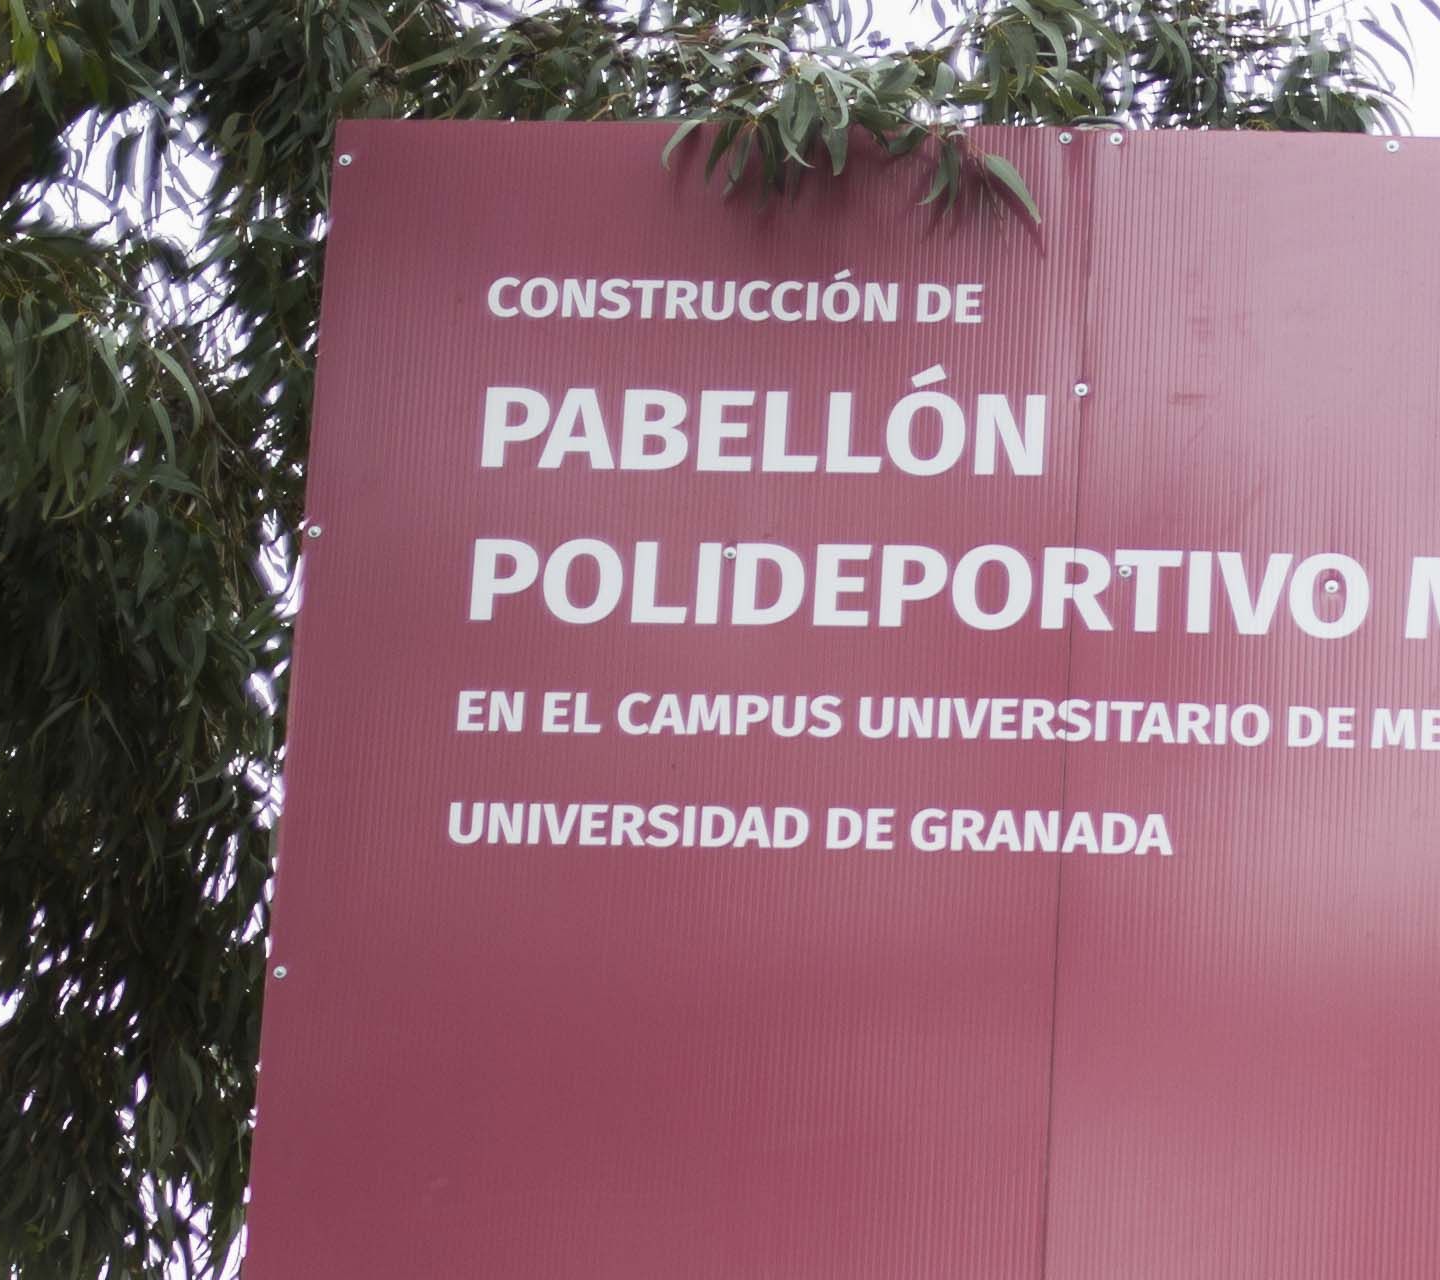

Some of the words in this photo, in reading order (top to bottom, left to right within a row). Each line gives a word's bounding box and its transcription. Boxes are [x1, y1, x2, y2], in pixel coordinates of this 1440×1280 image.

[488, 269, 898, 321] CONSTRUCCIÓN
[917, 284, 982, 323] DE
[482, 365, 1046, 475] PABELLÓN
[471, 539, 1370, 639] POLIDEPORTIVO
[457, 691, 524, 731] EN
[542, 692, 601, 733] EL
[618, 693, 841, 737] CAMPUS
[860, 697, 1269, 746] UNIVERSITARIO
[1289, 707, 1354, 747] DE
[449, 803, 808, 848] UNIVERSIDAD
[827, 808, 894, 849] DE
[911, 809, 1172, 855] GRANADA
